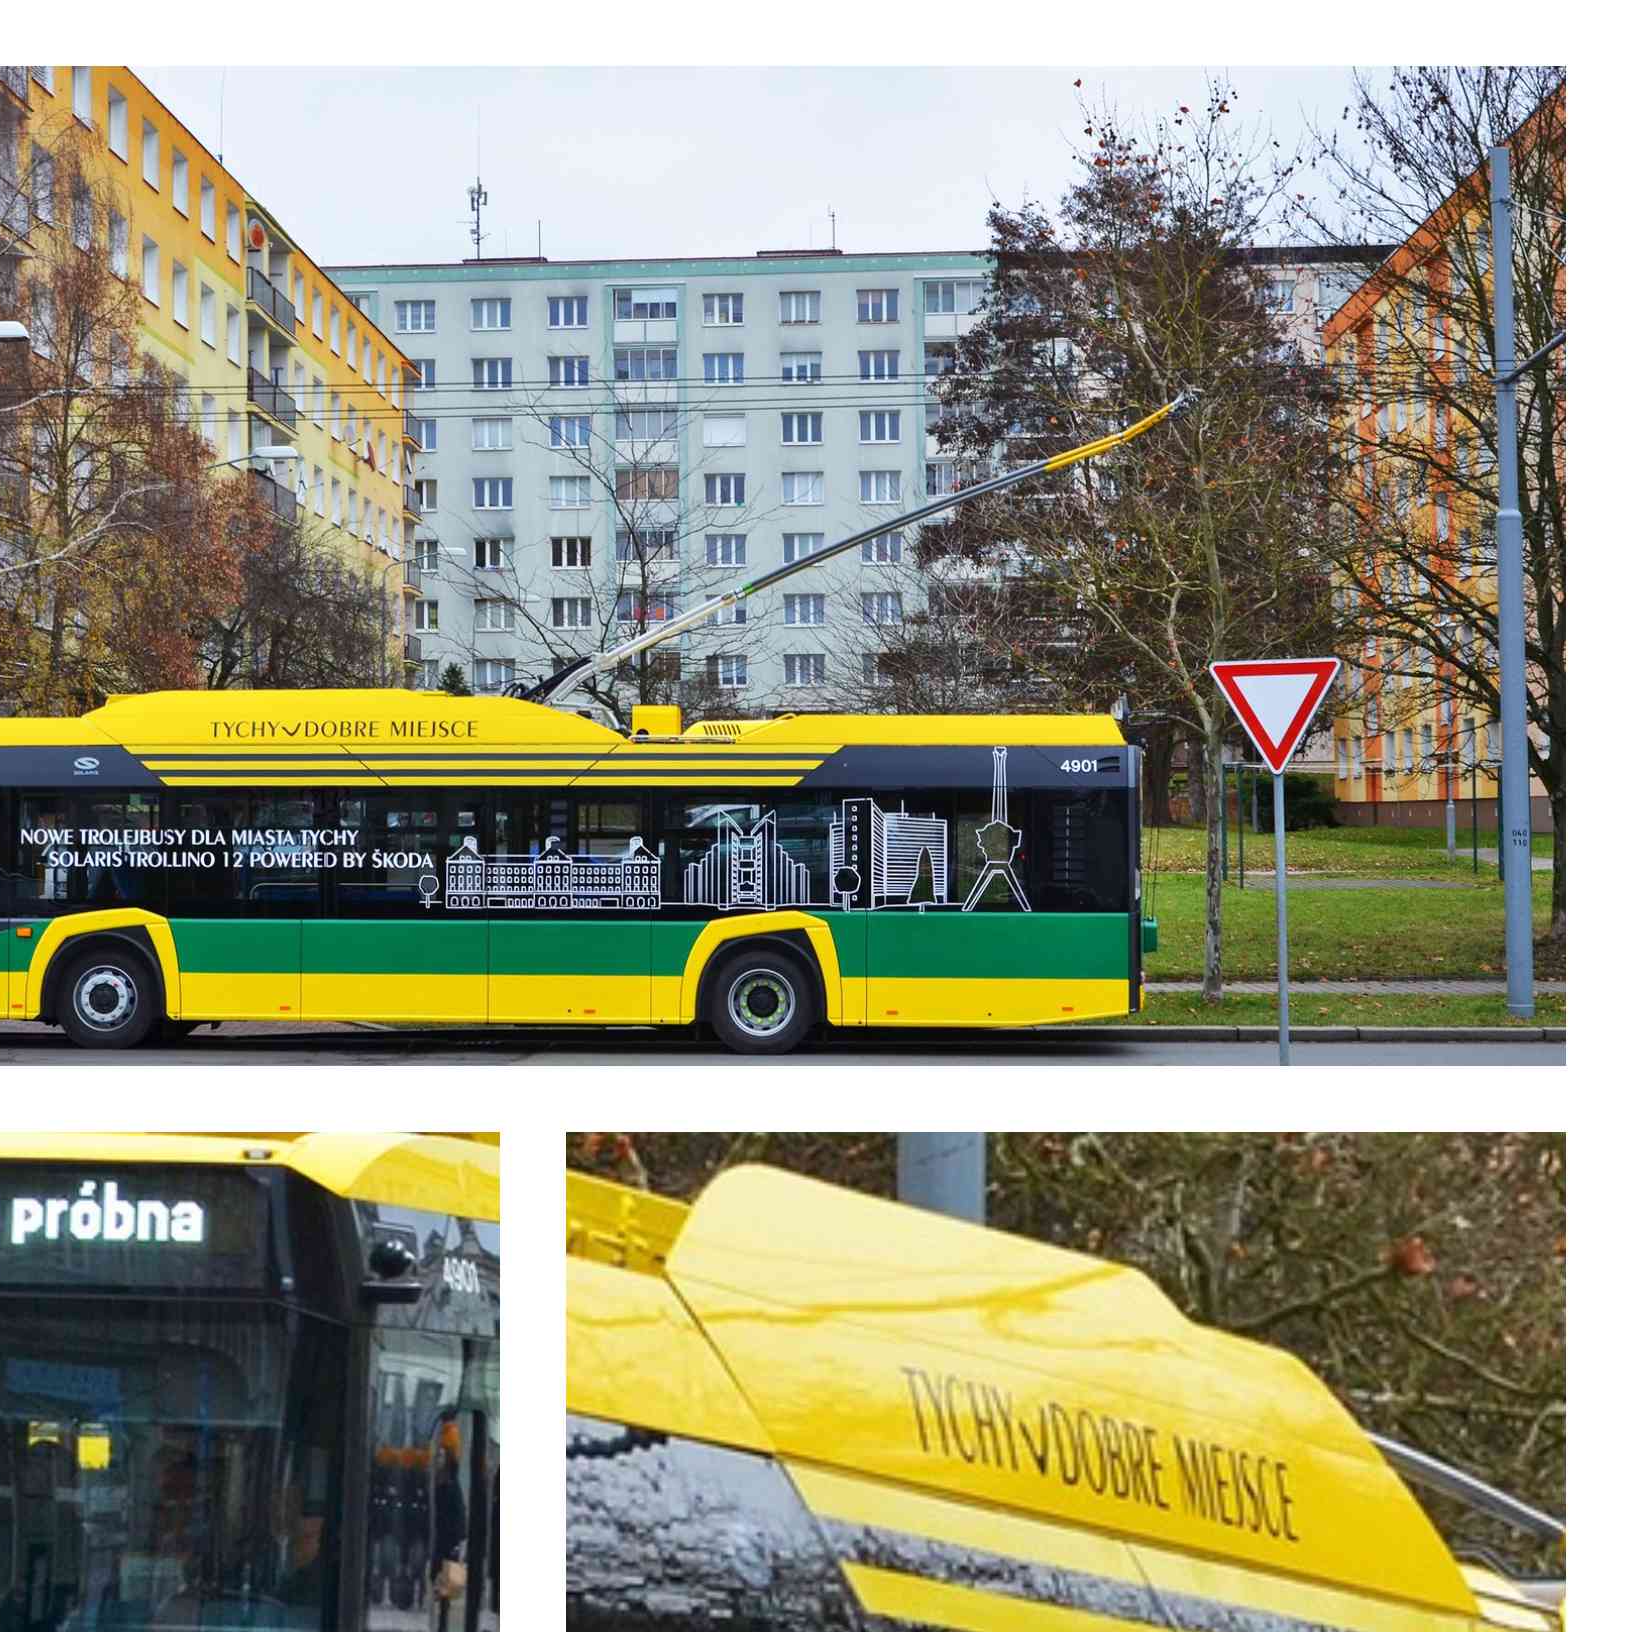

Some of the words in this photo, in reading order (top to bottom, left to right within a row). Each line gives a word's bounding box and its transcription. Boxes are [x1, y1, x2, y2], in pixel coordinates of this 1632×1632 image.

[210, 720, 280, 738] TYCHY
[304, 720, 381, 738] DOBRE
[390, 720, 480, 738] MIEJSCE
[1060, 760, 1097, 773] 4901
[20, 829, 74, 846] NOWE
[79, 829, 186, 846] TROLEJBUSY
[191, 829, 226, 846] DLA
[231, 829, 295, 846] MIASTA
[299, 829, 359, 846] TYCHY
[48, 851, 122, 868] SOLARIS
[125, 851, 216, 868] TROLLINO
[223, 852, 243, 868] 12
[250, 851, 337, 868] POWERED
[343, 852, 366, 868] BY
[371, 847, 434, 868] ŠKODA
[11, 1179, 204, 1245] próbna
[443, 1257, 480, 1293] 4901
[901, 1366, 1019, 1472] TYCHY
[1049, 1402, 1169, 1510] DOBRE
[1173, 1432, 1299, 1541] MIEJSCE
